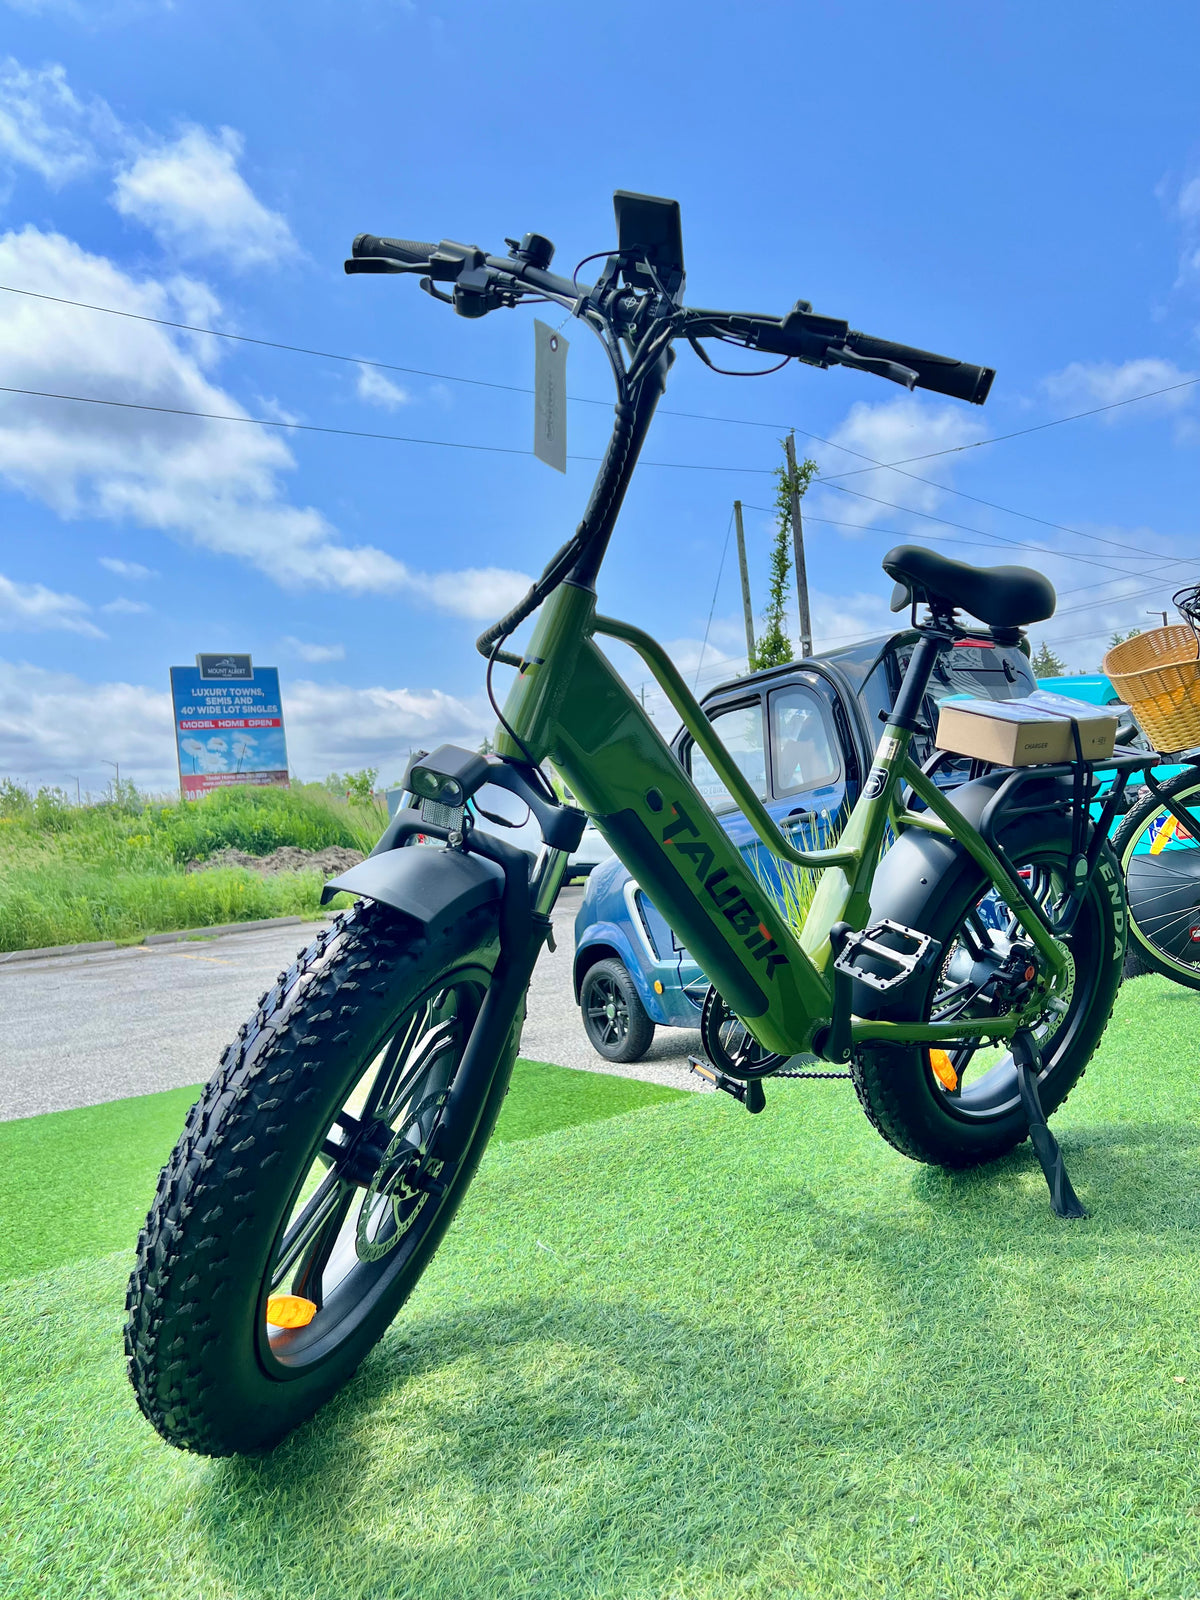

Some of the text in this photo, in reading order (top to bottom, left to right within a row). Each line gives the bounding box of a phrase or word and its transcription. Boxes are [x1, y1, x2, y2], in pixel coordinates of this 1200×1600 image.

[191, 688, 265, 697] LUXURY TOWNS,
[205, 697, 253, 705] SEMIS AND
[181, 705, 278, 715] 40' WIDE LOT SINGLES
[1024, 742, 1049, 750] CHARGER
[663, 800, 790, 981] TAUBIK
[1099, 853, 1124, 961] ENDA
